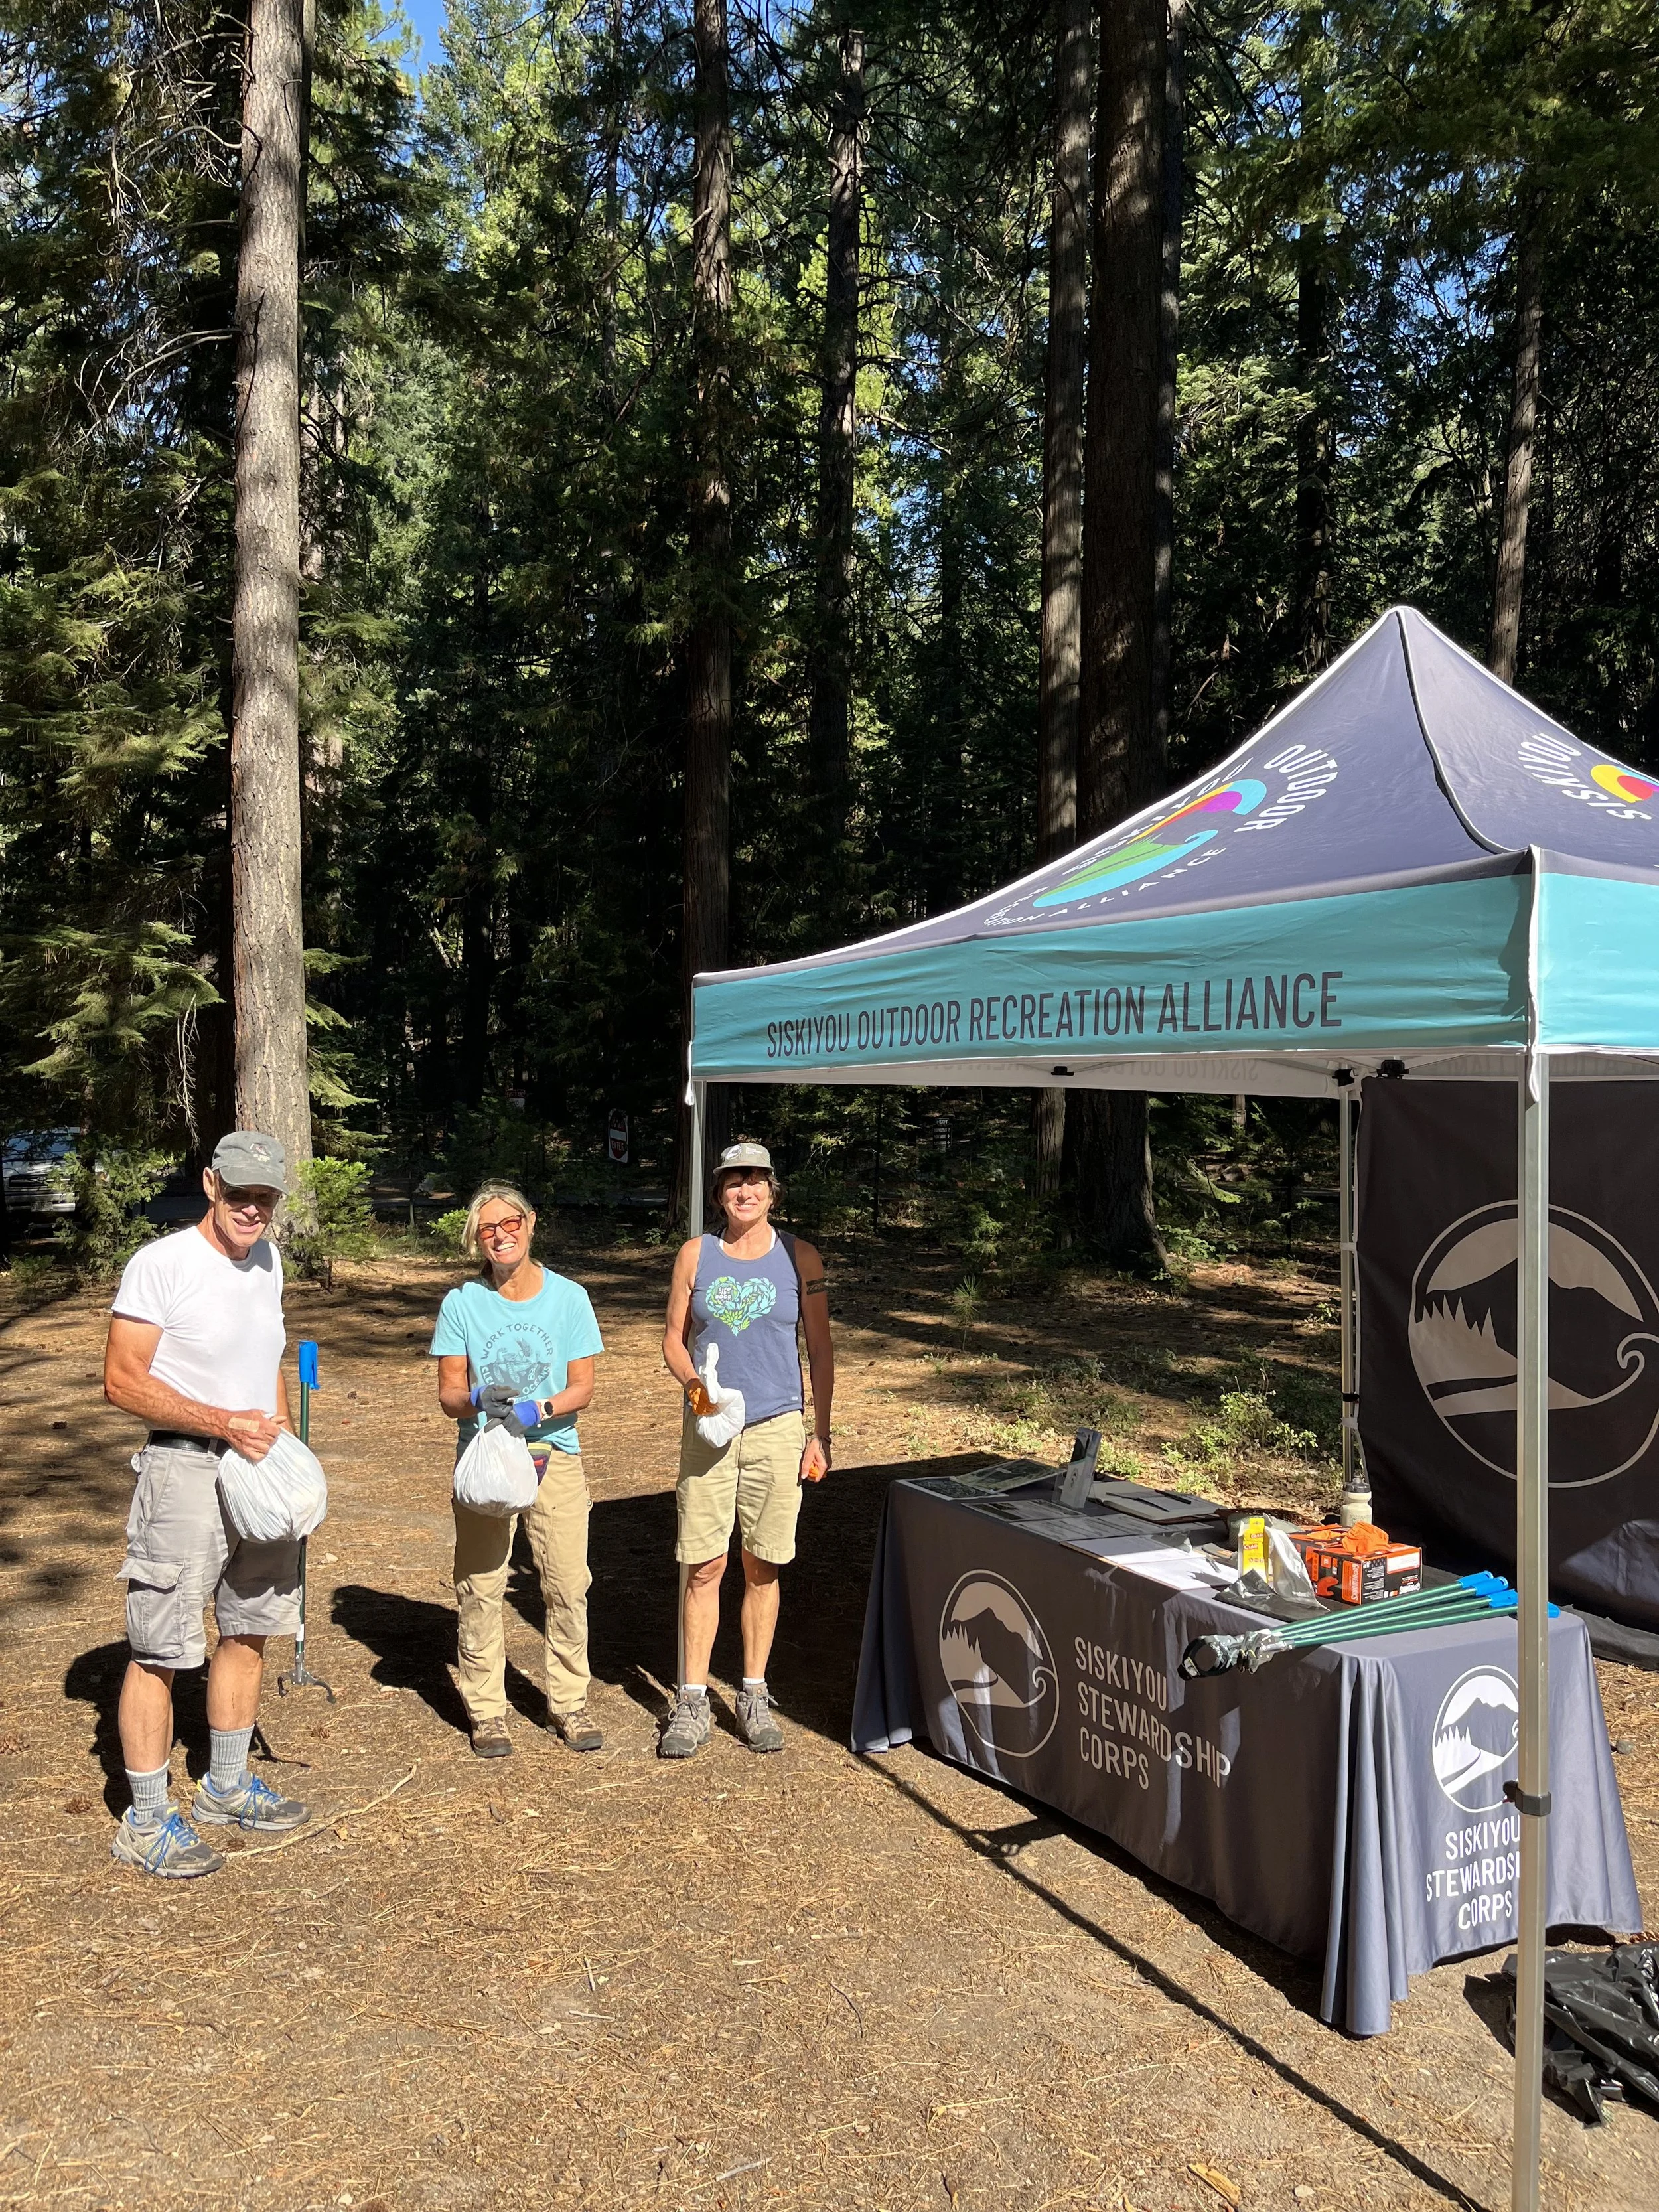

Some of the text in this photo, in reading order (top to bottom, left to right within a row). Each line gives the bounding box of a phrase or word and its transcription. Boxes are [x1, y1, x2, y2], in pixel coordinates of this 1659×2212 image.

[1233, 744, 1338, 832] OUTDOOR
[1517, 733, 1652, 820] SISKIYOU
[1048, 847, 1228, 917] ALLIANCE
[767, 971, 1344, 1058] SISKIYOU OUTDOOR RECREATION ALLIANCE
[480, 1323, 553, 1360] WORK TOGETHER
[522, 1365, 551, 1395] OCEANS
[1074, 1636, 1167, 1711] SISKIYOU
[1078, 1681, 1231, 1788] STEWARDSHIP
[1080, 1726, 1149, 1790] CORPS
[1445, 1814, 1520, 1860] SISKIYOU
[1458, 1890, 1512, 1929] CORPS
